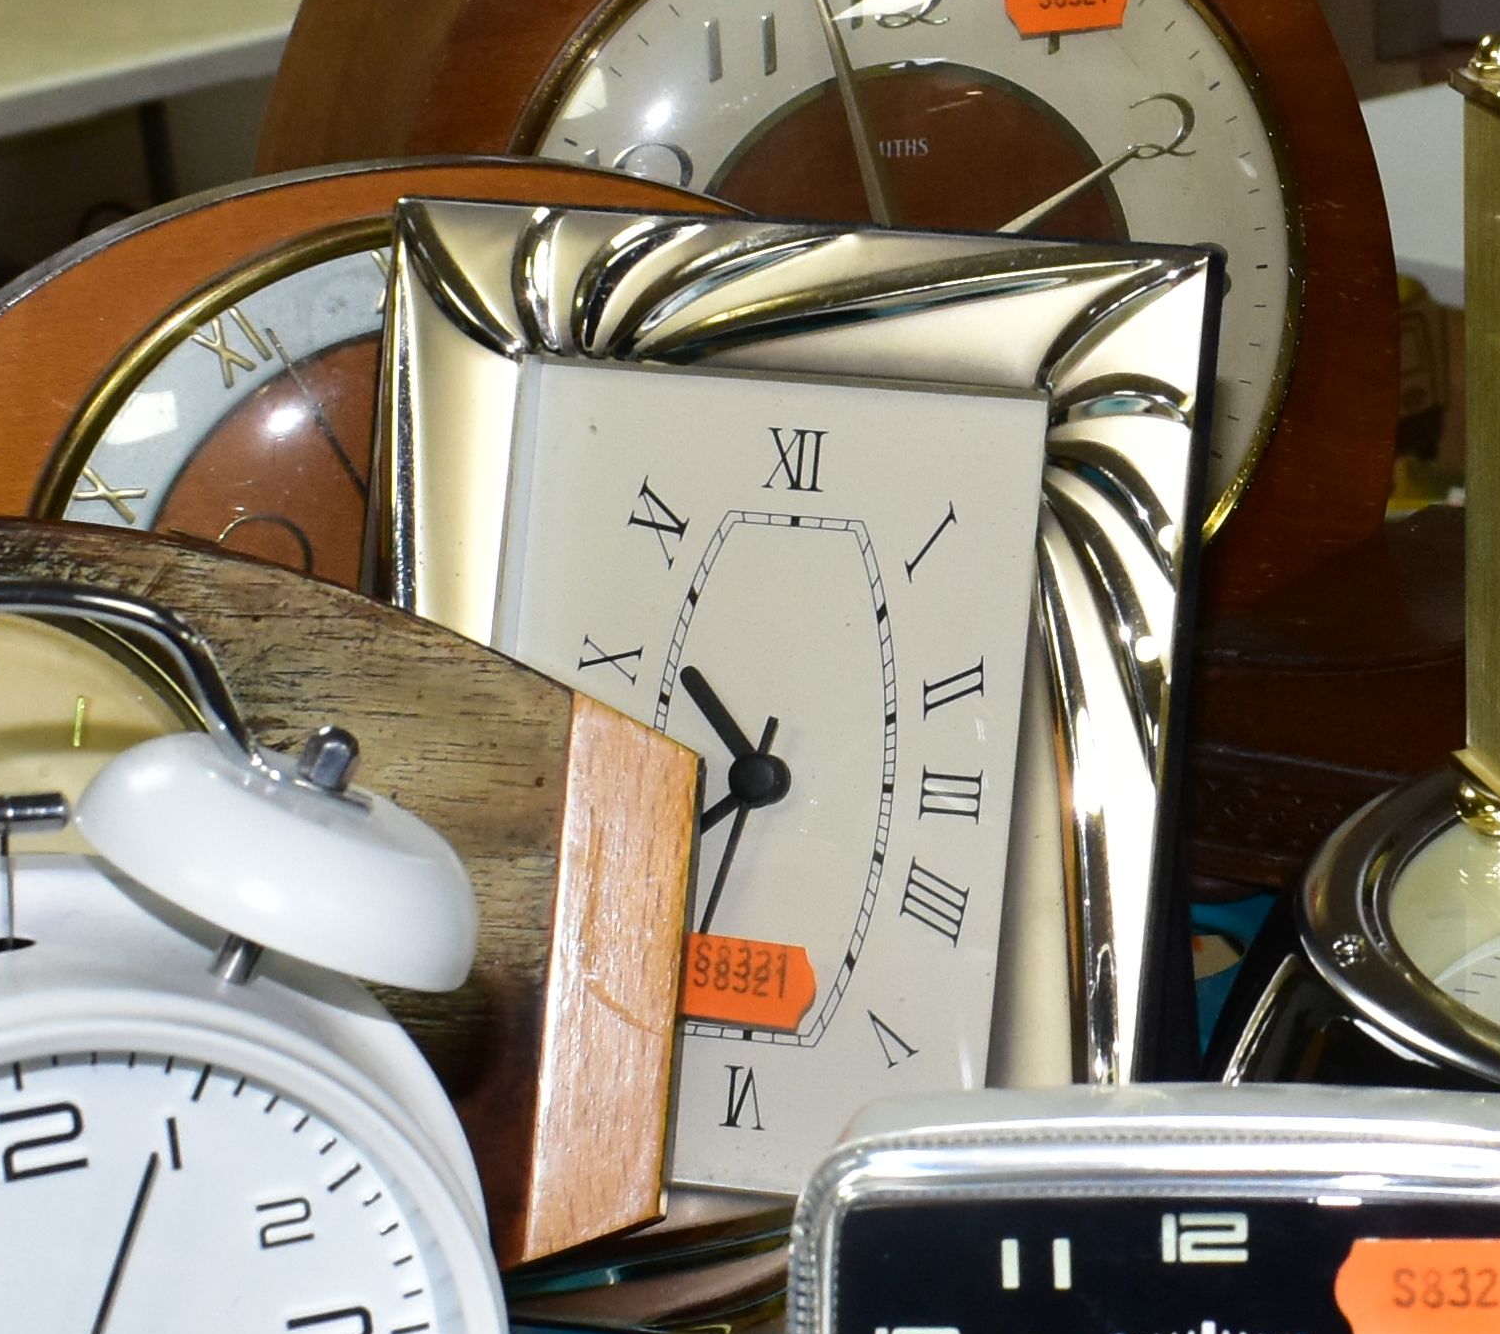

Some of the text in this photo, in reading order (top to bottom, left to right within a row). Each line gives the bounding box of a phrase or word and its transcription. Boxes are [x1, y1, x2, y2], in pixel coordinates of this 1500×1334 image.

[704, 10, 779, 83] 11
[1128, 93, 1197, 160] 2
[190, 305, 274, 388] XI
[761, 426, 827, 492] XII
[71, 465, 148, 524] X
[625, 474, 690, 569] XI
[577, 633, 644, 685] X
[923, 656, 985, 719] II
[919, 767, 983, 825] III
[899, 856, 970, 947] IIII
[867, 1008, 920, 1068] V
[718, 1064, 766, 1130] VI
[166, 1116, 183, 1171] 1
[255, 1194, 315, 1250] 2
[1160, 1212, 1250, 1264] 12
[1000, 1236, 1073, 1291] 11
